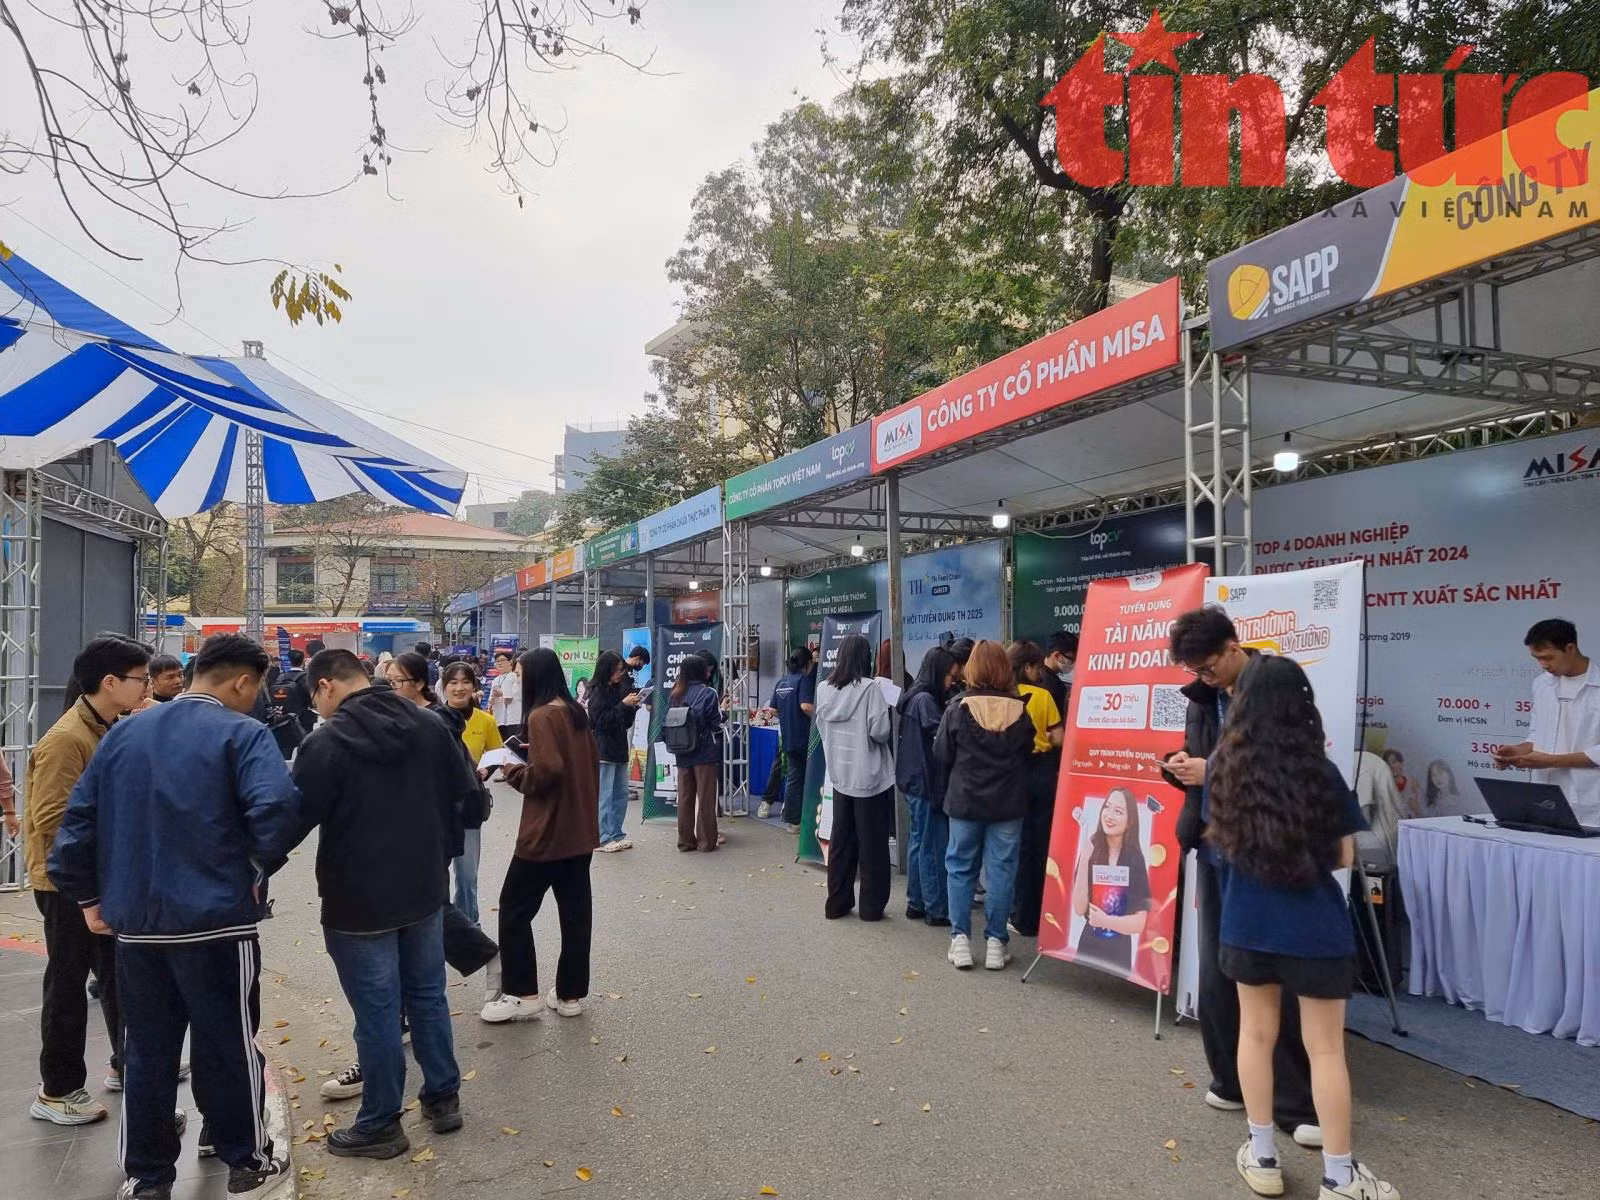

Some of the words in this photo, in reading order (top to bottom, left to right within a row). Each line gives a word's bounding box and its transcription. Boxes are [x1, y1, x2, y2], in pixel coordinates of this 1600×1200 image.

[1456, 164, 1538, 230] CÔNG
[1547, 140, 1592, 195] TY
[1272, 245, 1339, 306] SAPP
[927, 394, 973, 431] CÔNG
[977, 381, 999, 412] TY
[1003, 359, 1031, 401] CỔ
[1036, 339, 1096, 389] PHẦN
[1103, 314, 1165, 363] MISA
[884, 419, 913, 446] MISA
[805, 462, 821, 478] NAM
[1255, 540, 1280, 555] TOP
[1283, 539, 1291, 552] 4
[1294, 532, 1346, 551] DOANH
[1350, 522, 1409, 545] NGHIỆP
[1379, 545, 1422, 567] NHẤT
[1428, 545, 1469, 562] 2024
[1230, 587, 1247, 600] SAPP
[1366, 591, 1408, 607] CNTT
[1412, 583, 1458, 605] XUẤT
[1463, 582, 1500, 602] SẮC
[1506, 577, 1561, 601] NHẤT
[837, 605, 853, 613] MEDIA
[918, 608, 937, 624] TUYỂN
[938, 610, 956, 624] DỤNG
[957, 610, 966, 620] TH
[968, 609, 983, 620] 2025
[1120, 601, 1146, 614] TUYỂN
[1147, 599, 1173, 612] DỤNG
[1104, 622, 1128, 644] TÀI
[1245, 610, 1296, 640] TRƯỜNG
[1295, 624, 1329, 651] TƯỞNG
[1391, 632, 1411, 641] 2019
[667, 651, 693, 665] CHÍ
[1088, 652, 1126, 671] KINH
[1129, 649, 1175, 669] DOAN
[1103, 692, 1122, 711] 30
[1437, 698, 1479, 709] 70.000
[1516, 701, 1533, 712] 35
[1455, 716, 1462, 726] vị
[1464, 716, 1487, 725] HCSN
[1135, 752, 1156, 761] DỤNG
